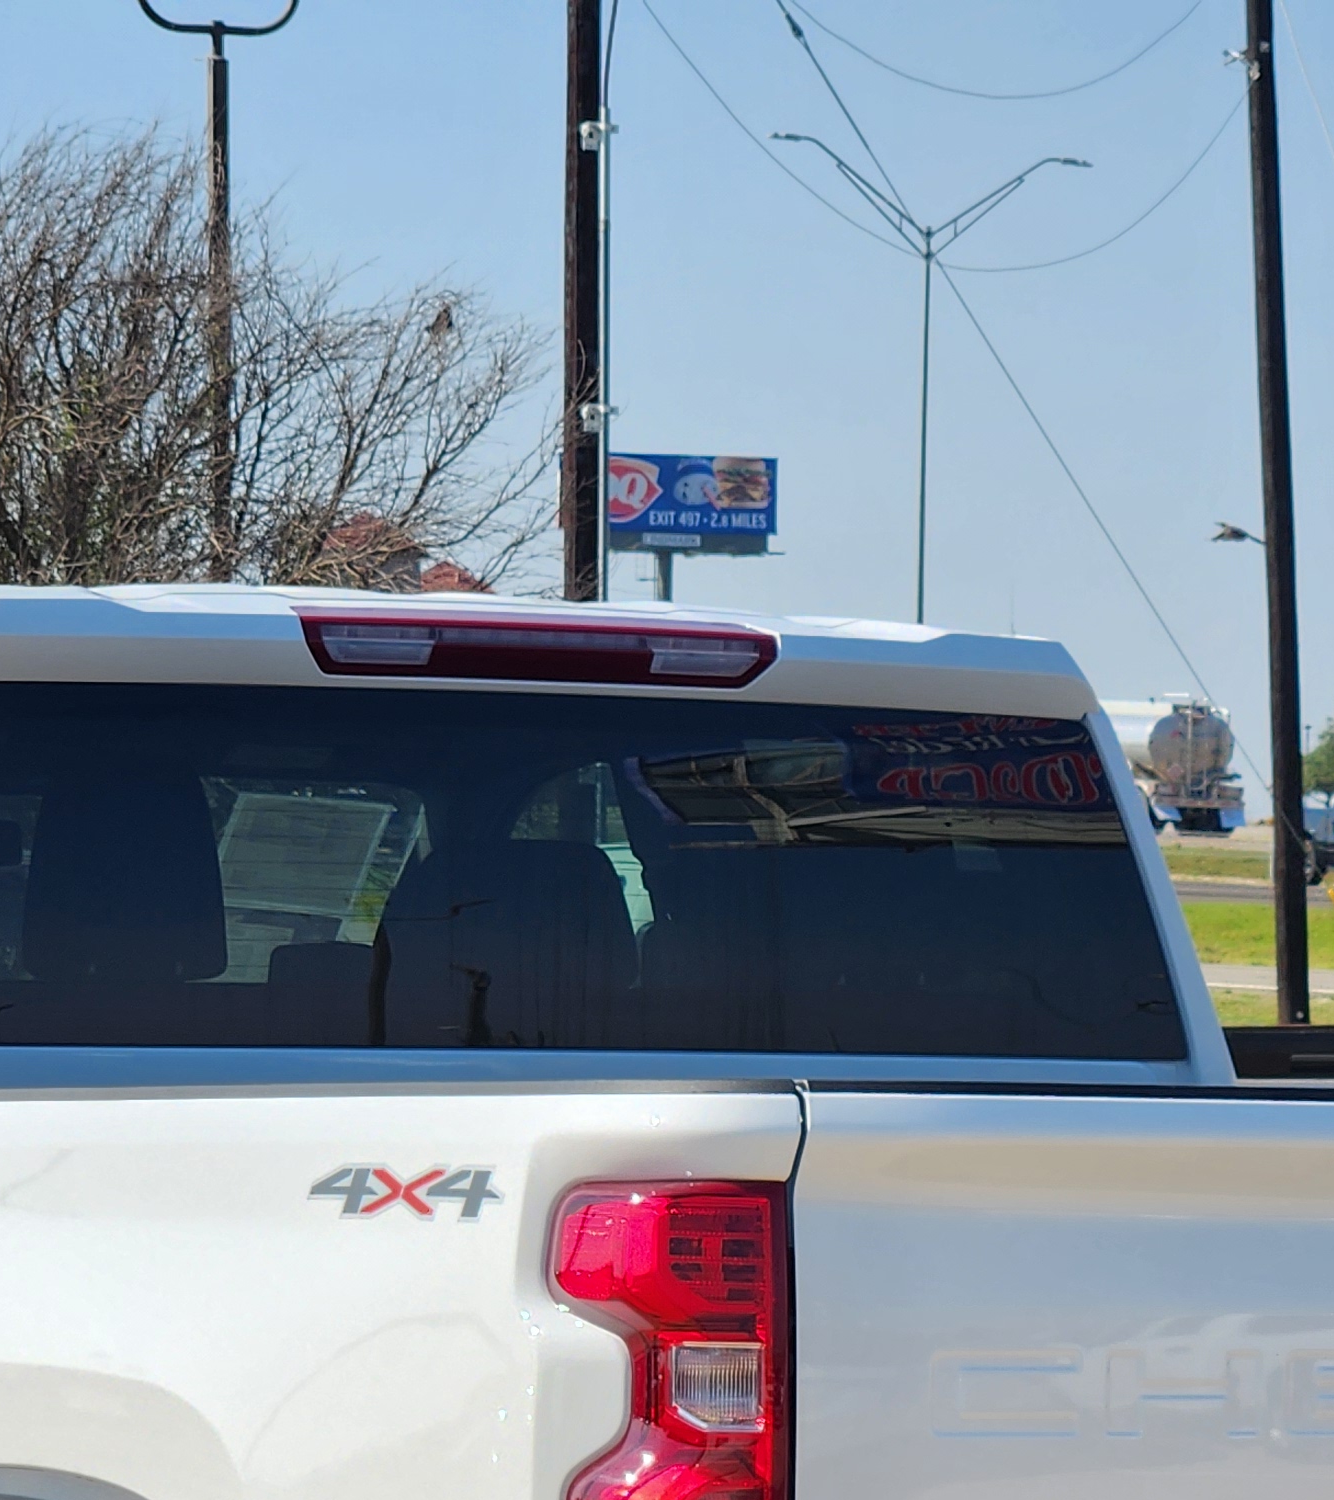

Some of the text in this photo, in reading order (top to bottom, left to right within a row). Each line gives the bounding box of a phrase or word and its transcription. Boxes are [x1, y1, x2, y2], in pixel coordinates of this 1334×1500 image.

[649, 510, 676, 526] EXIT
[678, 511, 701, 527] 497
[731, 512, 767, 530] MILES
